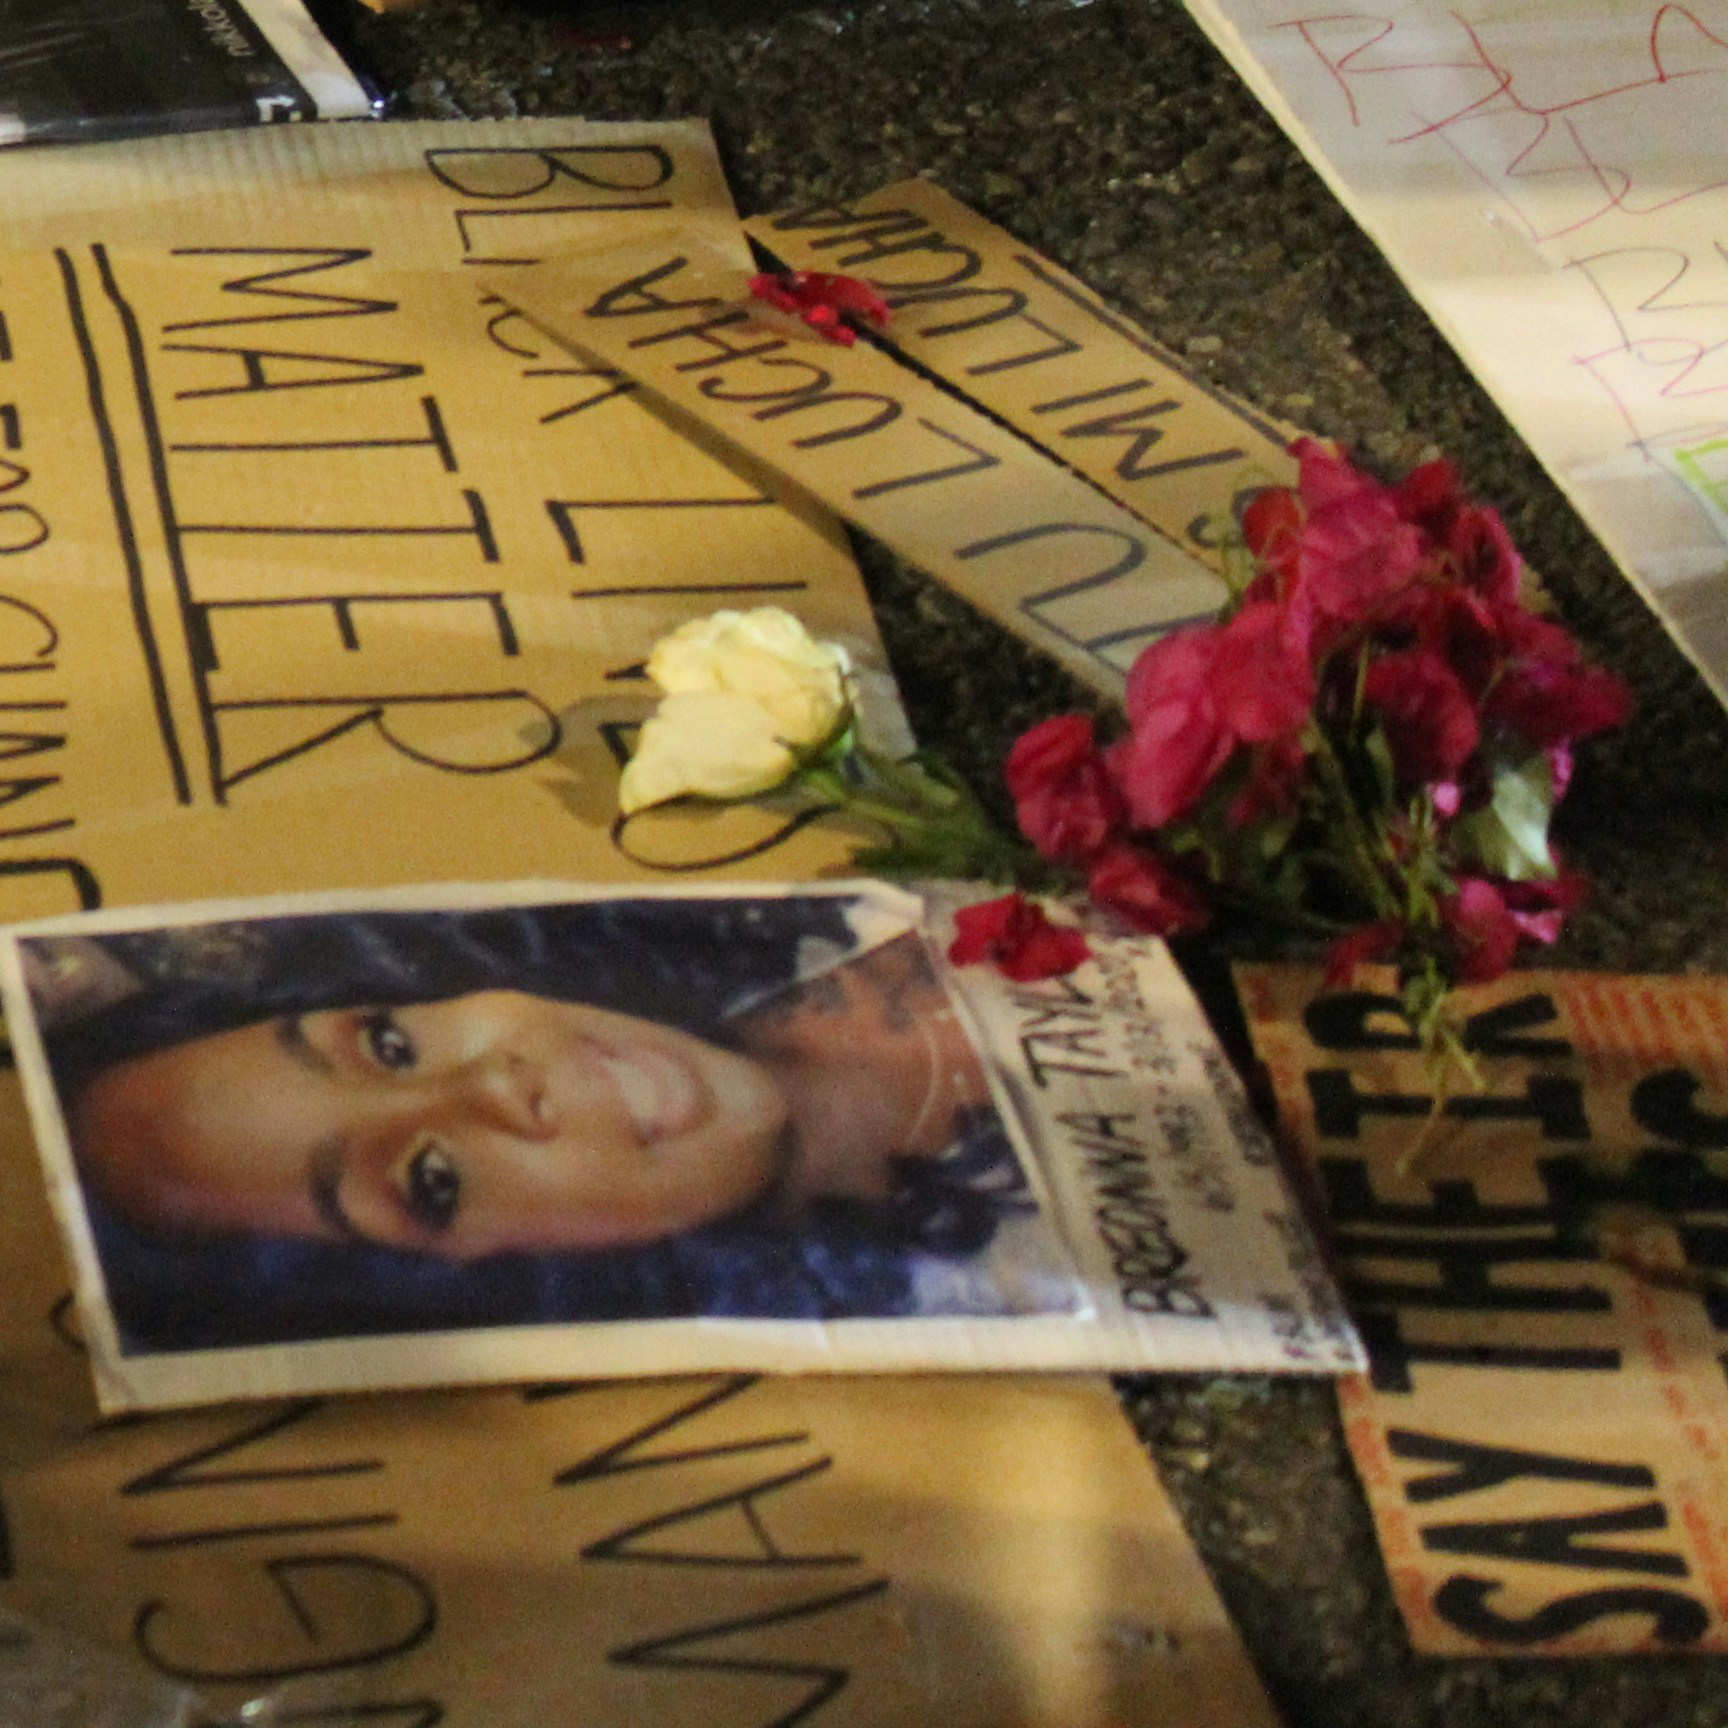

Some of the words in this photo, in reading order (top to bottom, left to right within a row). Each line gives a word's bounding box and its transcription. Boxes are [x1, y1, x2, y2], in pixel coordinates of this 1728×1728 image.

[584, 256, 1001, 504] LUCHA
[1030, 375, 1249, 486] MI
[161, 242, 565, 805] MATTER
[1302, 988, 1623, 1396] THEIR
[1387, 1425, 1711, 1645] SAY
